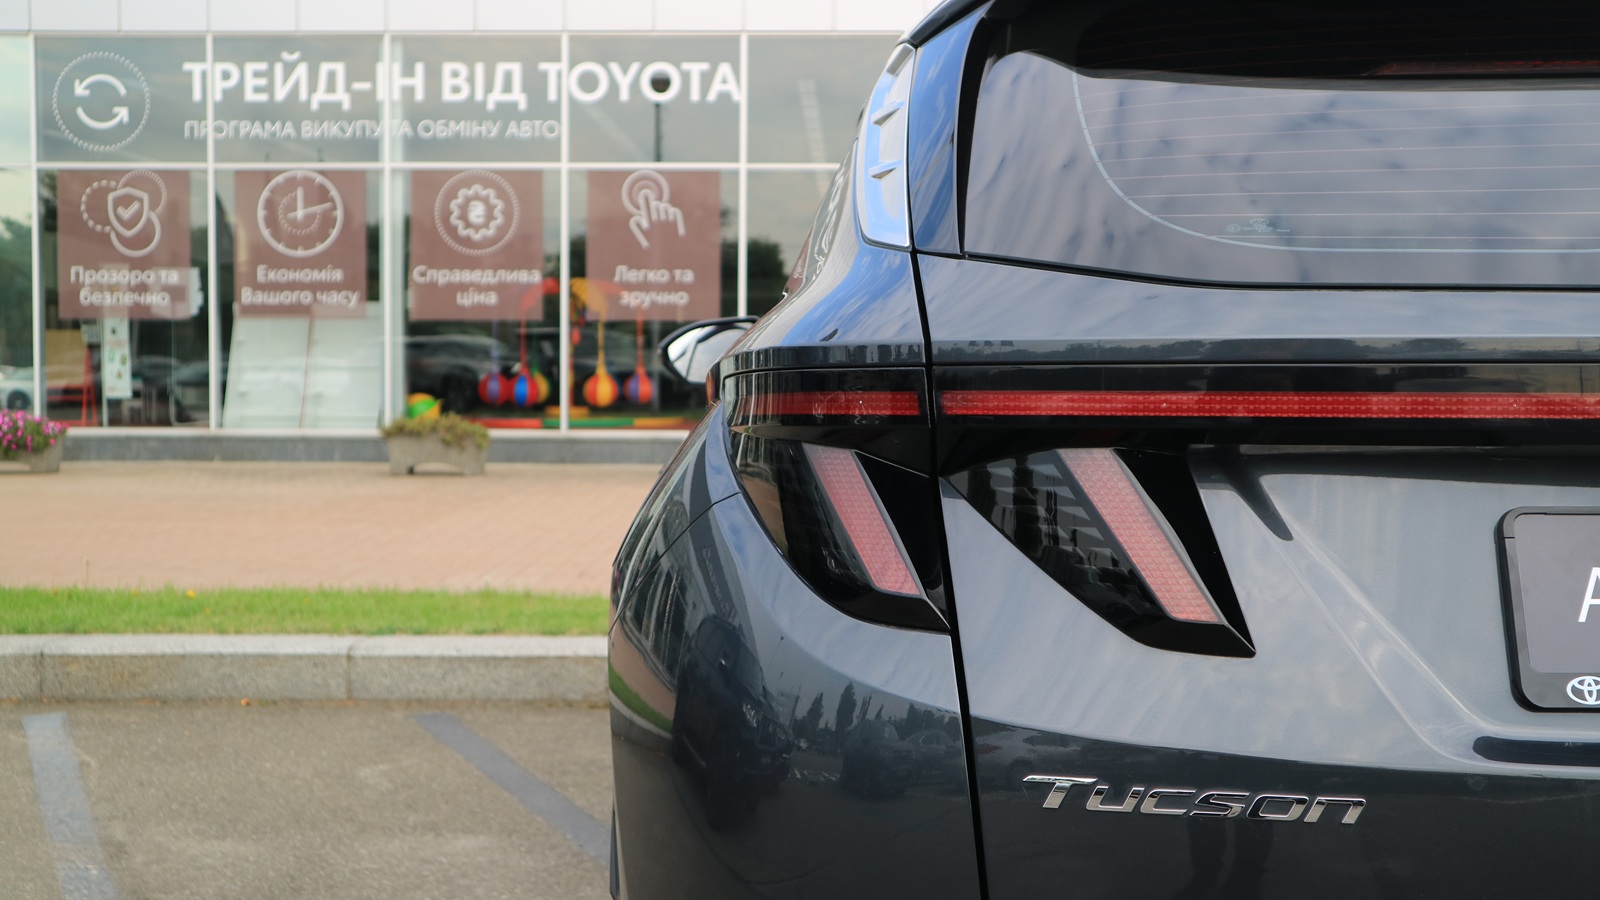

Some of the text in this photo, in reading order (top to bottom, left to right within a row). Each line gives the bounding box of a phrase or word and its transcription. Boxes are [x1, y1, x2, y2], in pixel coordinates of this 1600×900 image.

[182, 50, 741, 112] ТРЕЙД-ІН ВІД TOYOTA
[184, 119, 298, 140] ПРОГРАМА
[301, 119, 383, 140] ВИКУПУ
[416, 118, 500, 141] ОБМІНУ
[504, 118, 560, 140] АВТО
[70, 265, 180, 287] Прозоро та
[256, 264, 345, 284] Економія
[412, 264, 542, 287] Справедлива
[613, 264, 694, 285] Легко та
[79, 286, 171, 307] безпечно
[241, 286, 360, 309] Вашого часу
[456, 286, 499, 309] ціна
[618, 289, 690, 310] зручно
[1022, 774, 1367, 825] TUCSON
